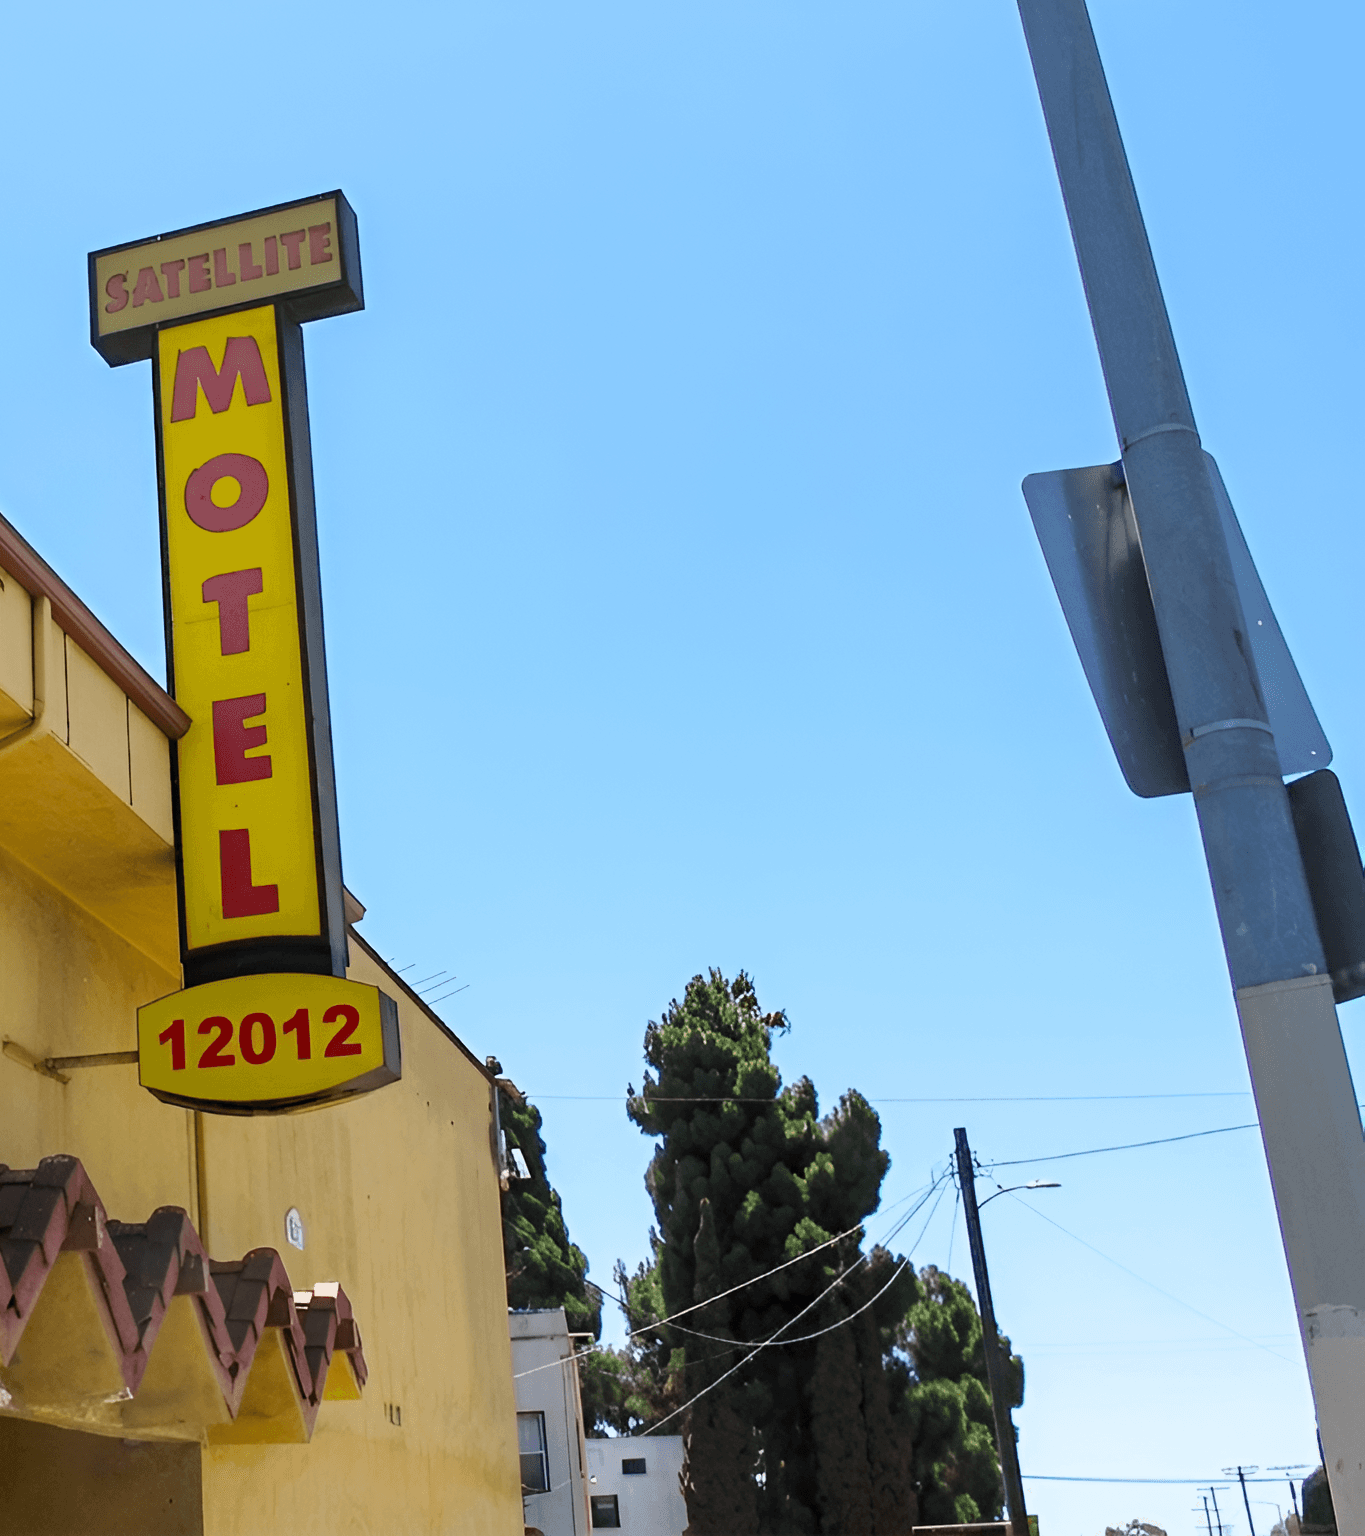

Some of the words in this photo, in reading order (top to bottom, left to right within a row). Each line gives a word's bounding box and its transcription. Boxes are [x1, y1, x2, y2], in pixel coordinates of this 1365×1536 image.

[105, 222, 333, 314] SATELLITE
[170, 335, 280, 919] MOTEL
[158, 1004, 362, 1071] 12012
